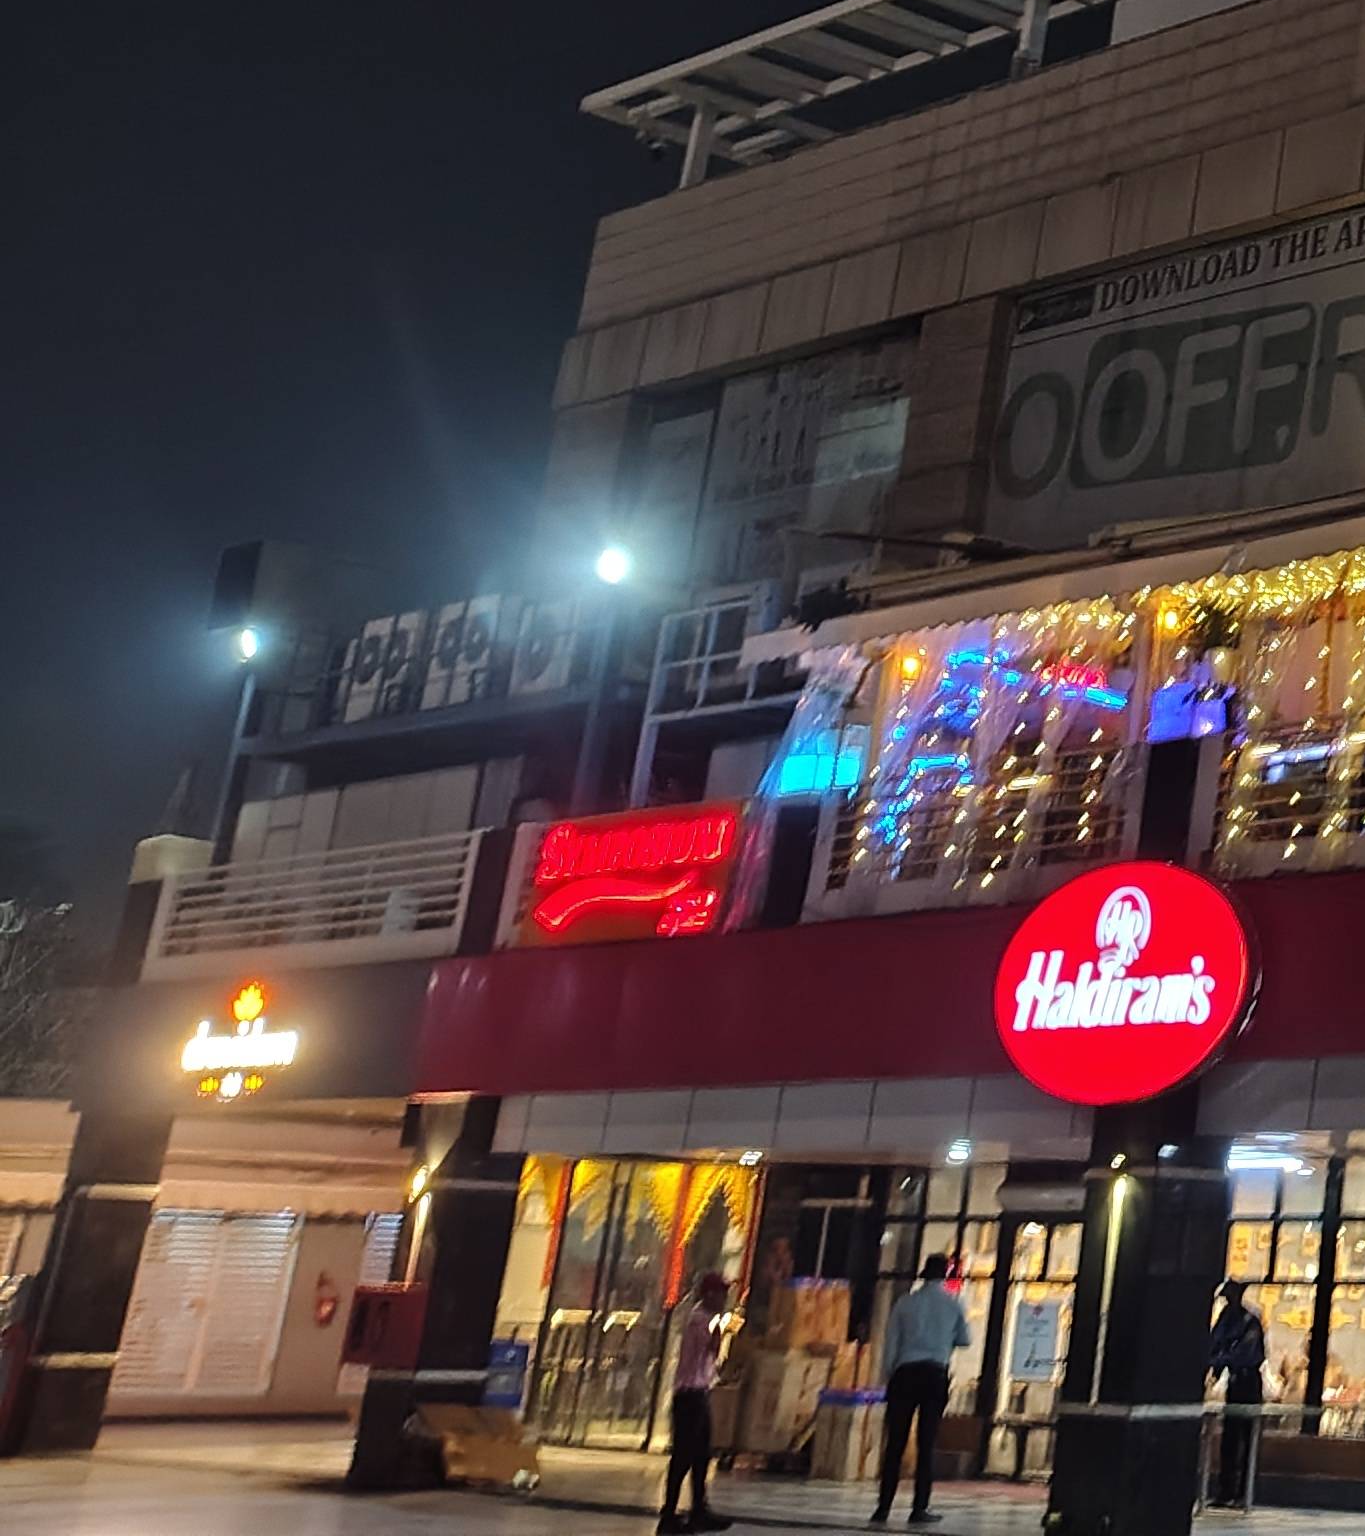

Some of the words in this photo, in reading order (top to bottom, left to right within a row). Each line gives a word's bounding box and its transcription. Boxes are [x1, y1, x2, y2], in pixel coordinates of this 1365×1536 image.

[1099, 242, 1260, 312] DOWNLOAD
[1269, 219, 1329, 268] THE
[1013, 950, 1216, 1032] Haldiram's
